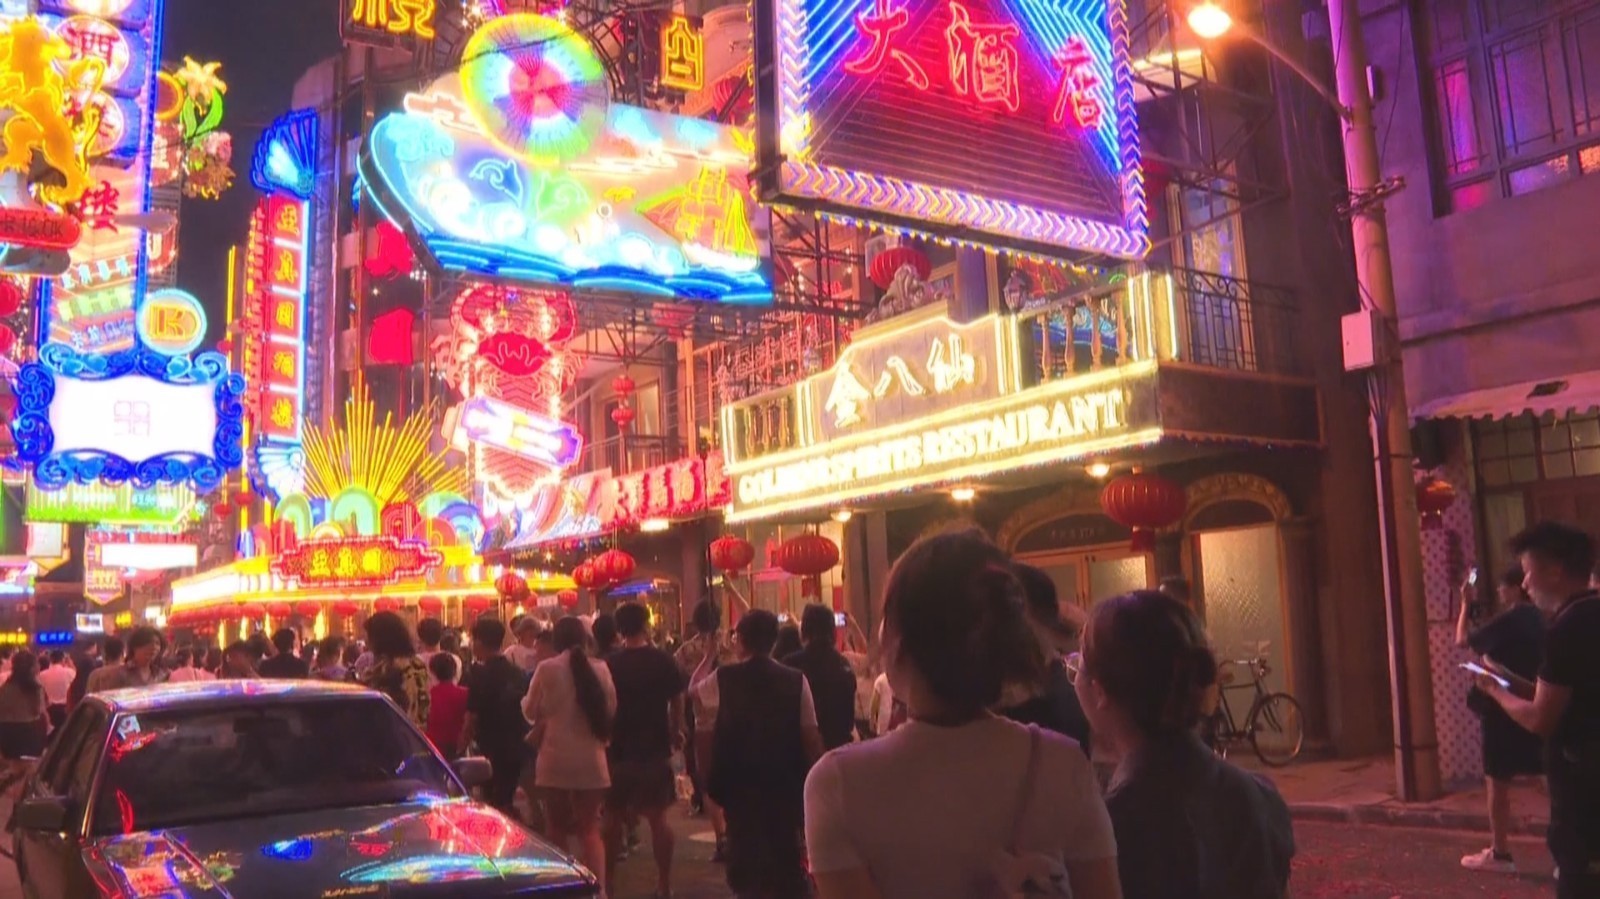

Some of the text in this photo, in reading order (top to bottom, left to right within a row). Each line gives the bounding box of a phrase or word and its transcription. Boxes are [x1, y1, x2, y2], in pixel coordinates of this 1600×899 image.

[825, 333, 975, 429] 金八仙
[922, 389, 1123, 465] RESTAURANT
